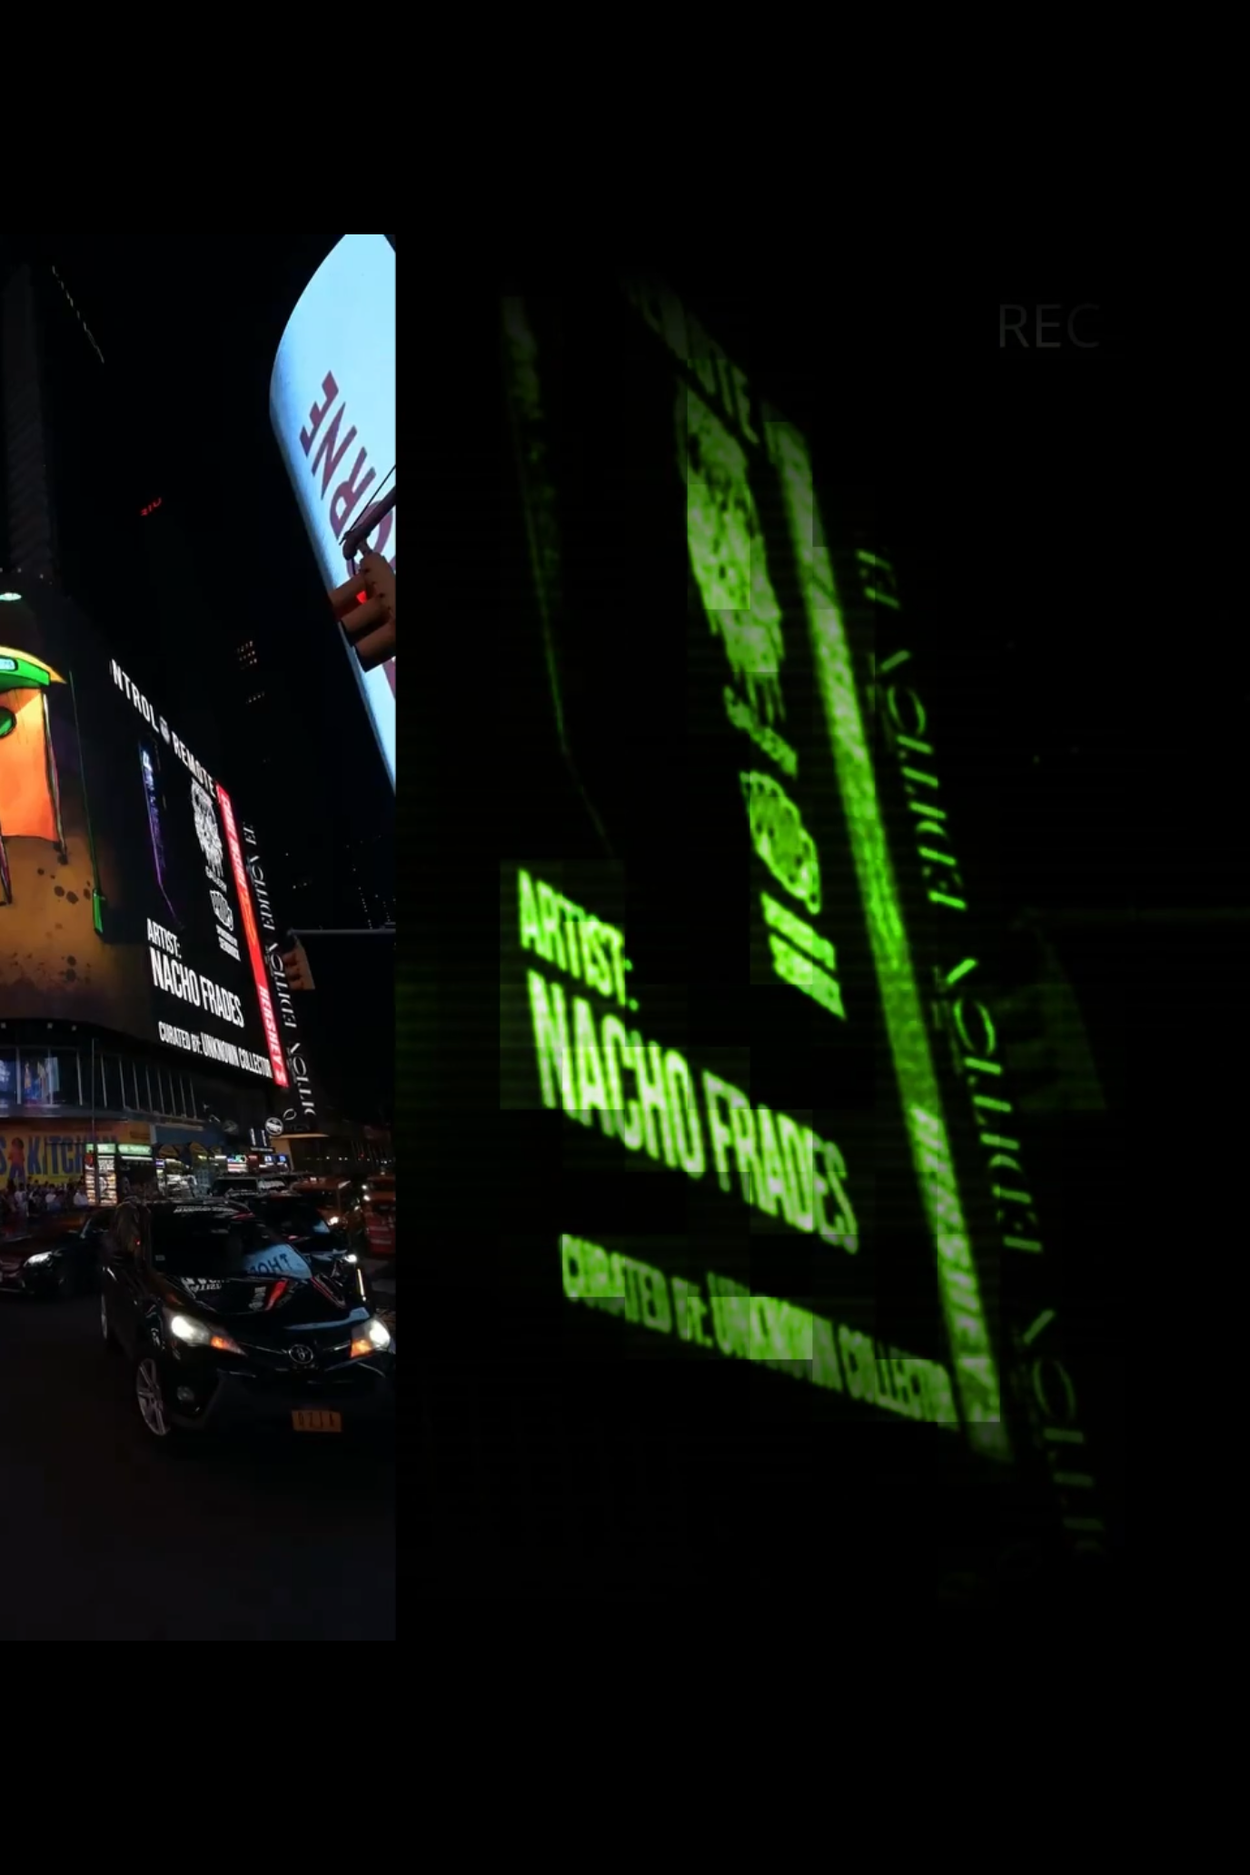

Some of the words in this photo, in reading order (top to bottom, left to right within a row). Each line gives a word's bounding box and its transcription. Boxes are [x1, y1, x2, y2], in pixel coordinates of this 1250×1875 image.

[110, 658, 160, 733] NTROL
[147, 917, 182, 959] ARTIST:
[517, 867, 641, 1013] ARTIST:
[149, 946, 201, 1007] NACHO
[199, 974, 245, 1028] FRADES
[158, 1020, 191, 1050] CURATED
[200, 1031, 240, 1067] UNKNOWN
[257, 985, 287, 1082] HERSHEY'S
[526, 968, 705, 1181] NACHO
[699, 1067, 861, 1255] FRADES
